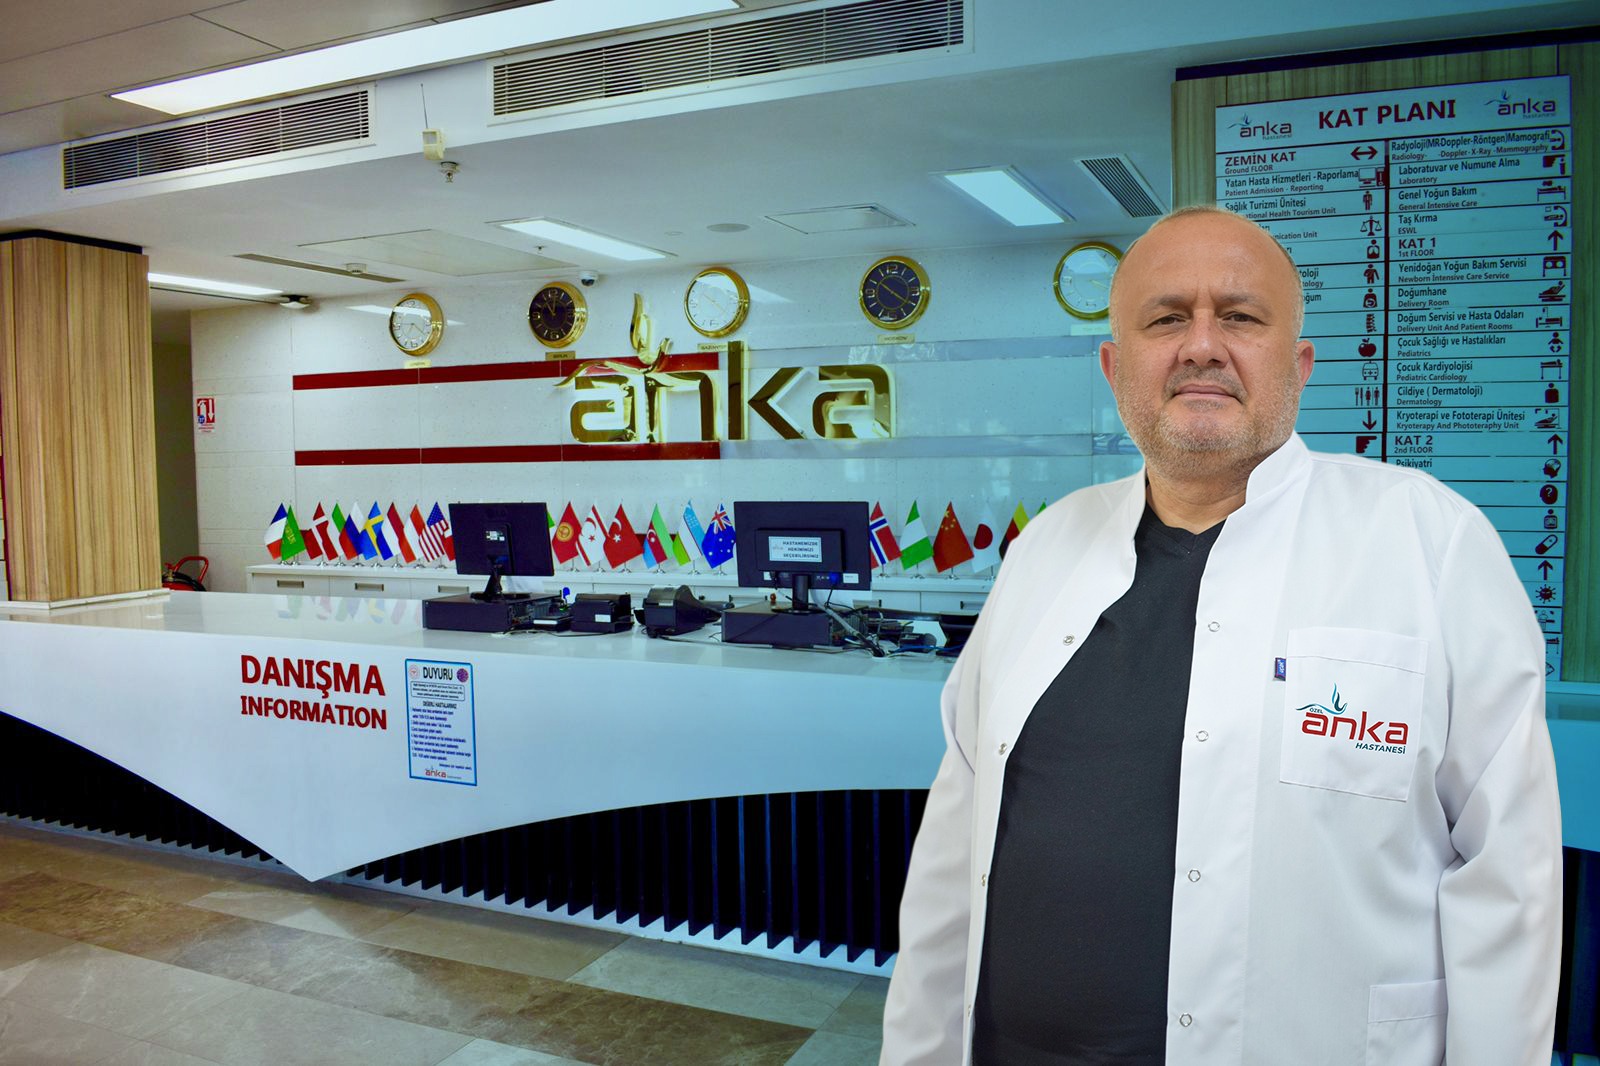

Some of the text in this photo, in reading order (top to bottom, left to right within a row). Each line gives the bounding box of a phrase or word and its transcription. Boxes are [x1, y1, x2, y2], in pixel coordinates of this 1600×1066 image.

[1319, 98, 1456, 129] KAT PLANI
[1498, 98, 1556, 116] anka
[1240, 121, 1292, 138] anka
[1225, 152, 1296, 167] ZEMİN KAT
[1225, 164, 1273, 174] Ground FLOOR
[1398, 158, 1520, 176] Laboratuvar ve Numune Alma
[1225, 178, 1247, 188] Yatan
[1248, 176, 1270, 186] Hasta
[1272, 172, 1311, 184] Hizmetleri
[1399, 175, 1438, 185] Laboratory
[1225, 189, 1248, 197] Patient
[1250, 186, 1284, 195] Admission
[1290, 184, 1324, 193] Reporting
[1398, 186, 1477, 200] Genel Yoğun Bakım
[1225, 197, 1306, 213] Sağlık Turizmi Ünitesi
[1398, 203, 1426, 211] General
[1427, 201, 1460, 210] Intensive
[1269, 208, 1291, 217] Health
[1292, 208, 1320, 216] Tourism
[1321, 207, 1336, 215] Unit
[1398, 213, 1438, 224] Taş Kırma
[1398, 237, 1436, 249] KAT 1
[1398, 258, 1527, 274] Yenidoğan Yoğun Bakım Servisi
[1398, 274, 1431, 283] Newborn
[1484, 272, 1510, 280] Service
[1398, 286, 1447, 299] Doğumhane
[1398, 300, 1426, 309] Delivery
[1397, 312, 1427, 324] Doğum
[1429, 311, 1455, 322] Servisi
[1468, 310, 1492, 320] Hasta
[1494, 309, 1524, 319] Odaları
[1397, 325, 1425, 334] Delivery
[1397, 337, 1421, 348] Çocuk
[1422, 336, 1449, 348] Sağlığı
[1462, 334, 1506, 345] Hastalıkları
[1396, 360, 1473, 373] Çocuk Kardiyolojisi
[1428, 373, 1467, 383] Cardiology
[569, 340, 896, 444] anka
[1397, 386, 1424, 397] Cildiye
[1396, 398, 1442, 406] Dermatology
[1396, 410, 1438, 422] Kryoterapi
[1452, 410, 1494, 422] Fototerapi
[1497, 409, 1525, 420] Ünitesi
[1396, 422, 1435, 430] Kryoterapy
[1395, 435, 1433, 446] KAT 2
[1396, 458, 1432, 469] Psikiyatri
[241, 654, 386, 699] DANIŞMA
[423, 666, 453, 680] DUYURU
[240, 695, 387, 730] INFORMATION
[1301, 711, 1409, 745] anka
[1356, 742, 1406, 754] HASTANESİ
[425, 769, 446, 778] anka
